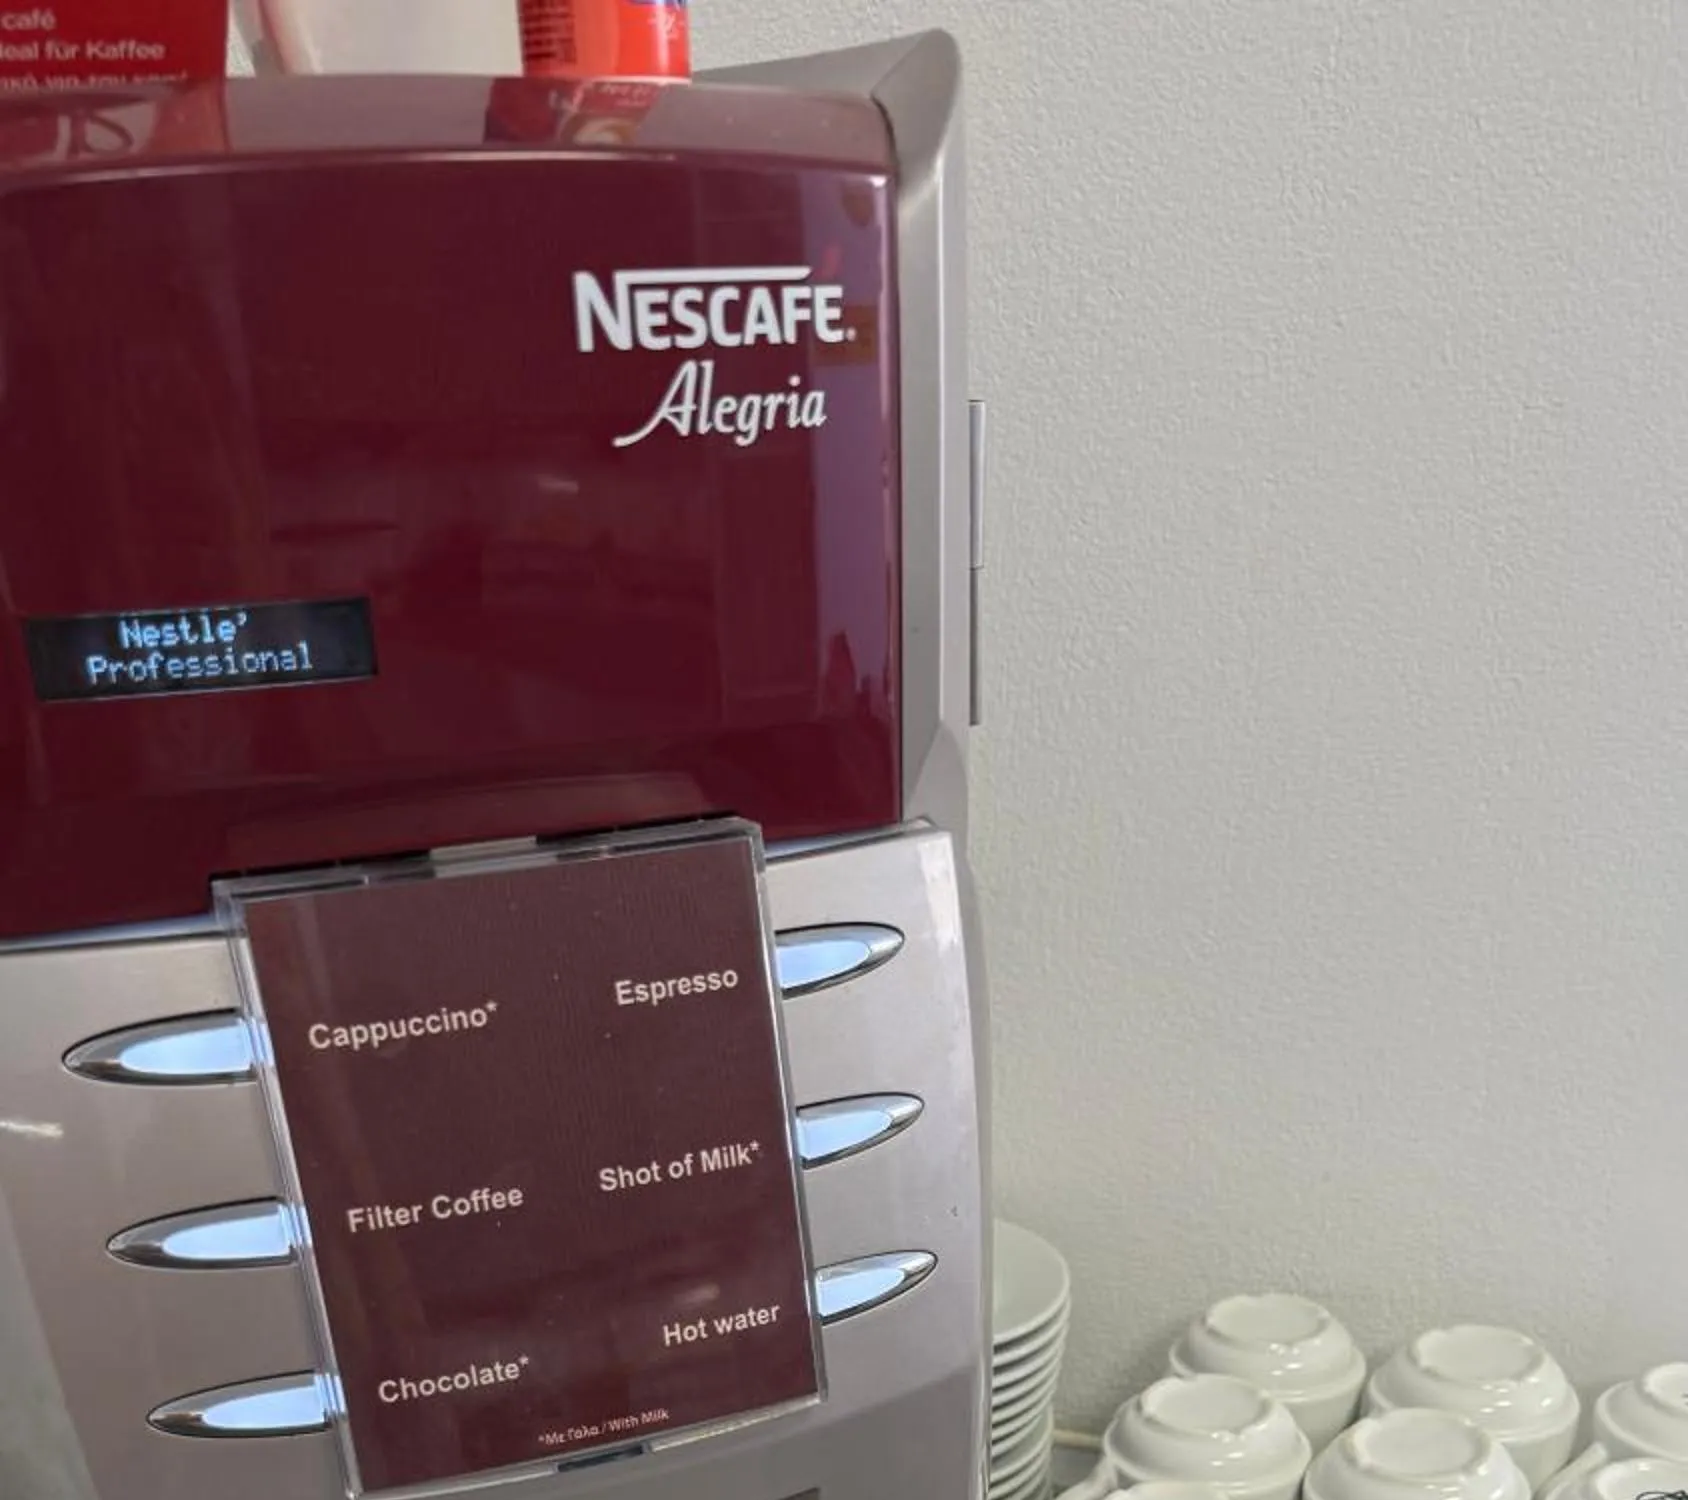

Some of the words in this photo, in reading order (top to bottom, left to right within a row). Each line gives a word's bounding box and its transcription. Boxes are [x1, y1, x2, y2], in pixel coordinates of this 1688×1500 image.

[0, 42, 39, 60] eal
[85, 40, 166, 60] Kaffee
[612, 359, 827, 447] Alegria
[86, 640, 313, 685] Professional
[614, 969, 739, 1006] Espresso
[599, 1165, 662, 1193] Shot
[668, 1154, 695, 1180] of
[347, 1201, 423, 1234] Filter
[431, 1186, 525, 1221] Coffee
[662, 1321, 708, 1347] Hot
[714, 1304, 782, 1333] water
[608, 1415, 639, 1432] With
[641, 1407, 670, 1424] Milk
